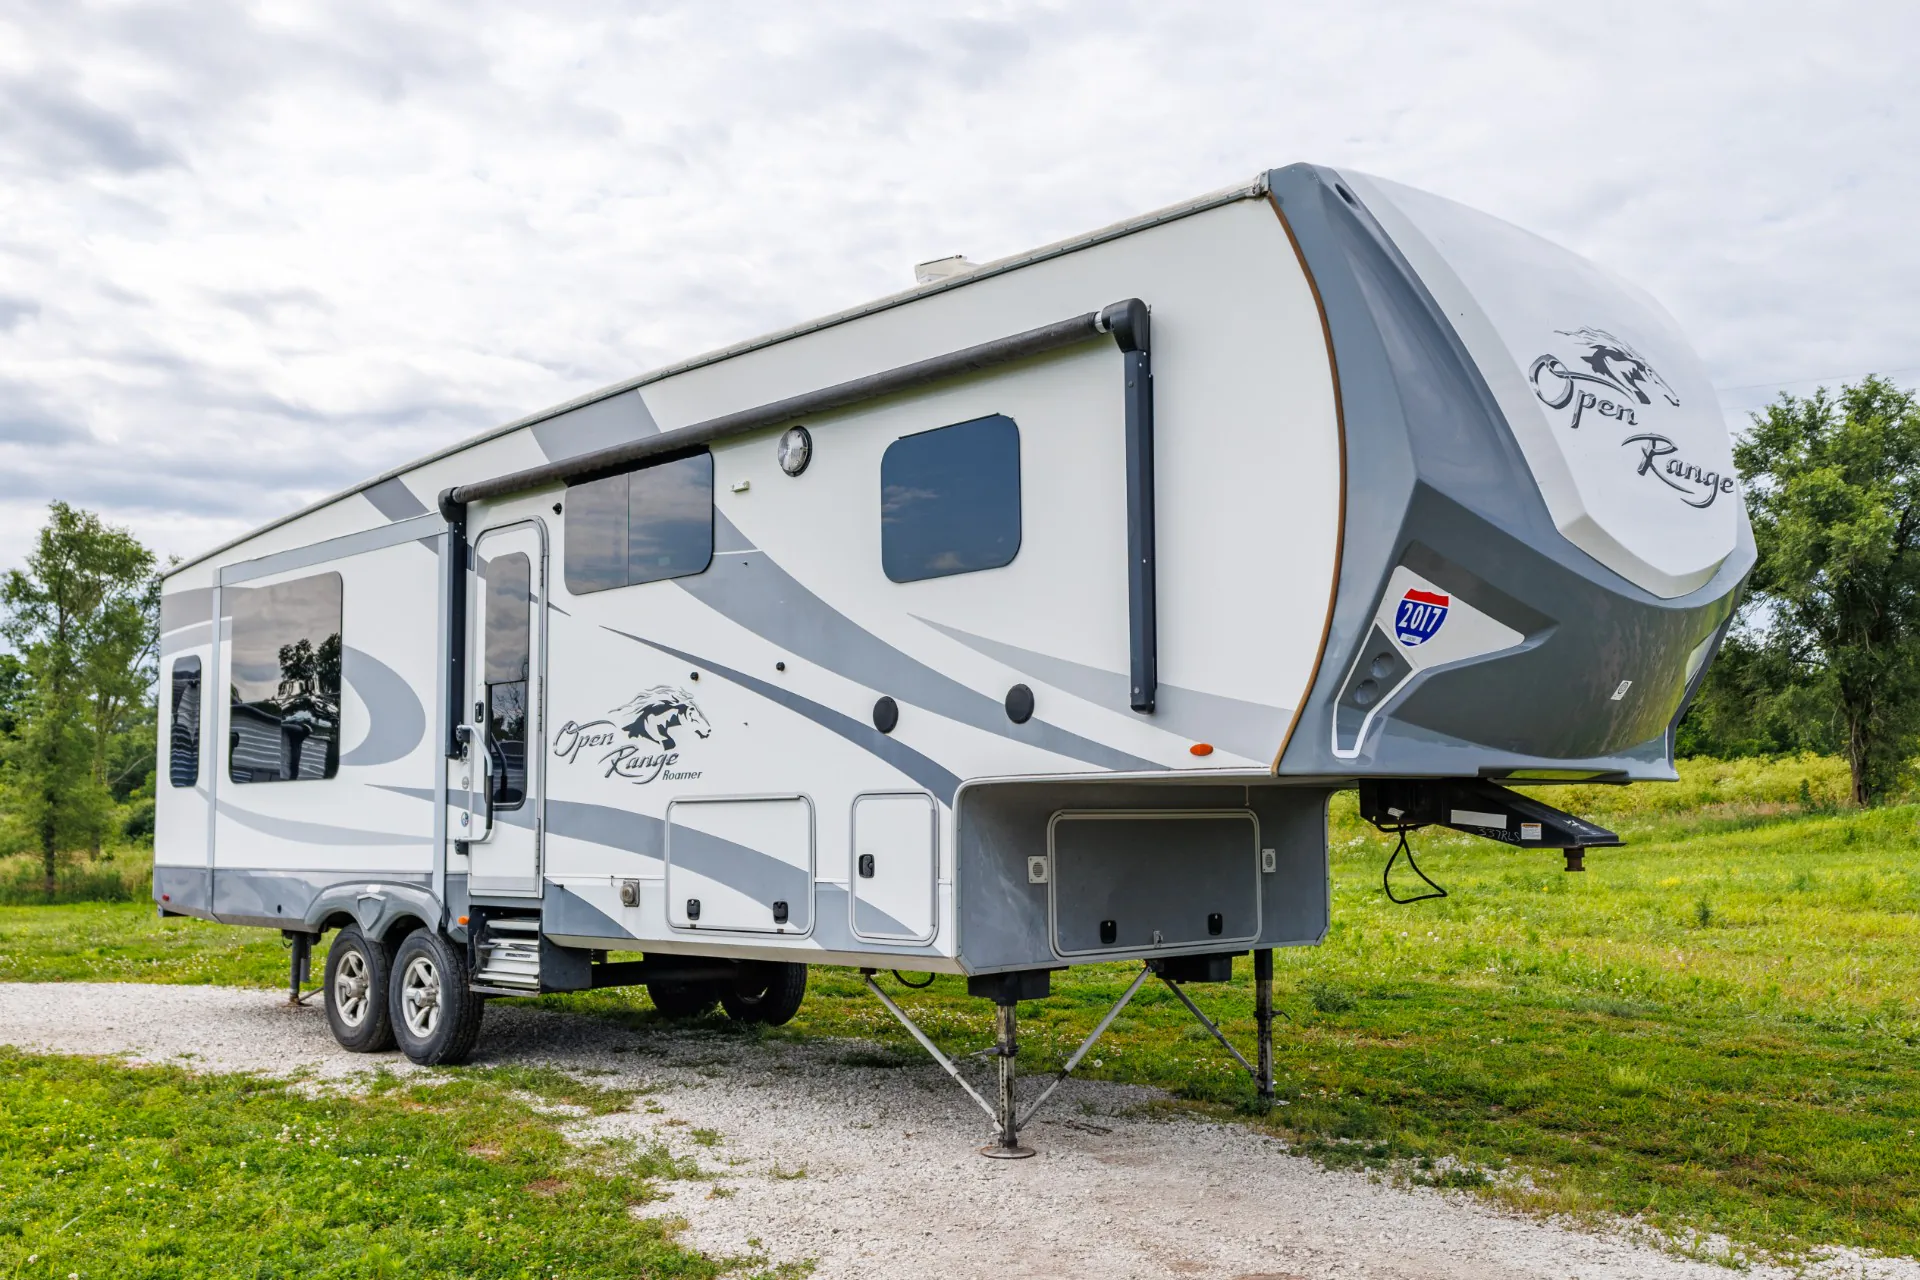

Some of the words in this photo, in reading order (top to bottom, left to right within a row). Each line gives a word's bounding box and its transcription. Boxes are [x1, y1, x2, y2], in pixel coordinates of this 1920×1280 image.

[1528, 353, 1638, 429] Open
[1621, 432, 1734, 509] Range
[1398, 602, 1443, 633] 2017
[552, 720, 617, 765] Open
[598, 744, 680, 785] Range
[662, 769, 703, 781] Roamer
[1477, 826, 1521, 843] 337RLS
